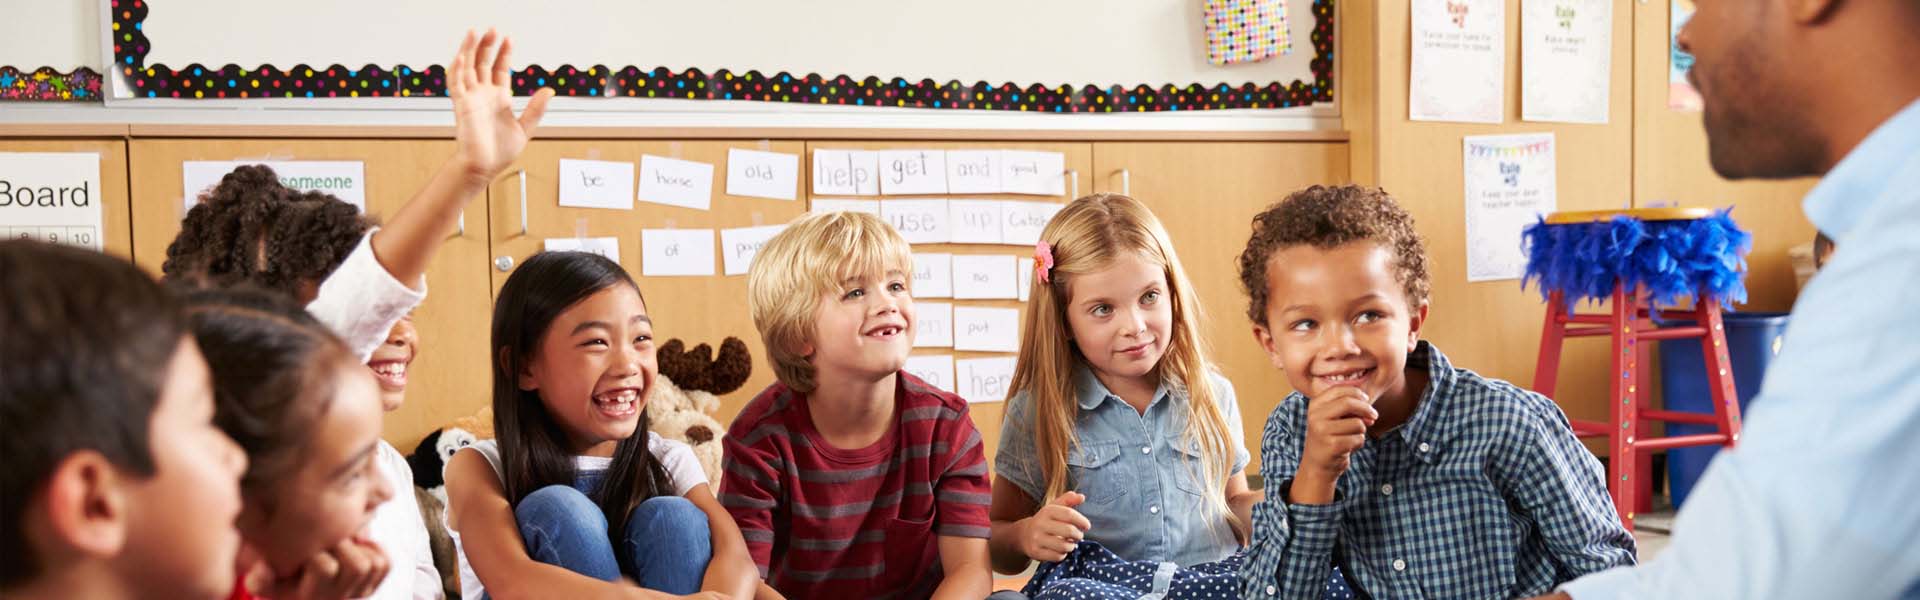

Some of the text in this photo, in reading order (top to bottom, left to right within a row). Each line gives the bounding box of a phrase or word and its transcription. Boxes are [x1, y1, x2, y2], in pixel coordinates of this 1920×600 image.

[1555, 4, 1576, 19] Rule
[744, 163, 774, 181] old
[818, 152, 868, 194] help
[892, 152, 928, 185] get
[958, 155, 990, 176] and
[1499, 161, 1520, 175] Rule
[281, 175, 353, 190] someone
[580, 170, 605, 188] be
[0, 180, 89, 208] Board
[891, 212, 936, 232] use
[74, 233, 90, 244] 10
[664, 241, 681, 257] of
[968, 319, 989, 336] put
